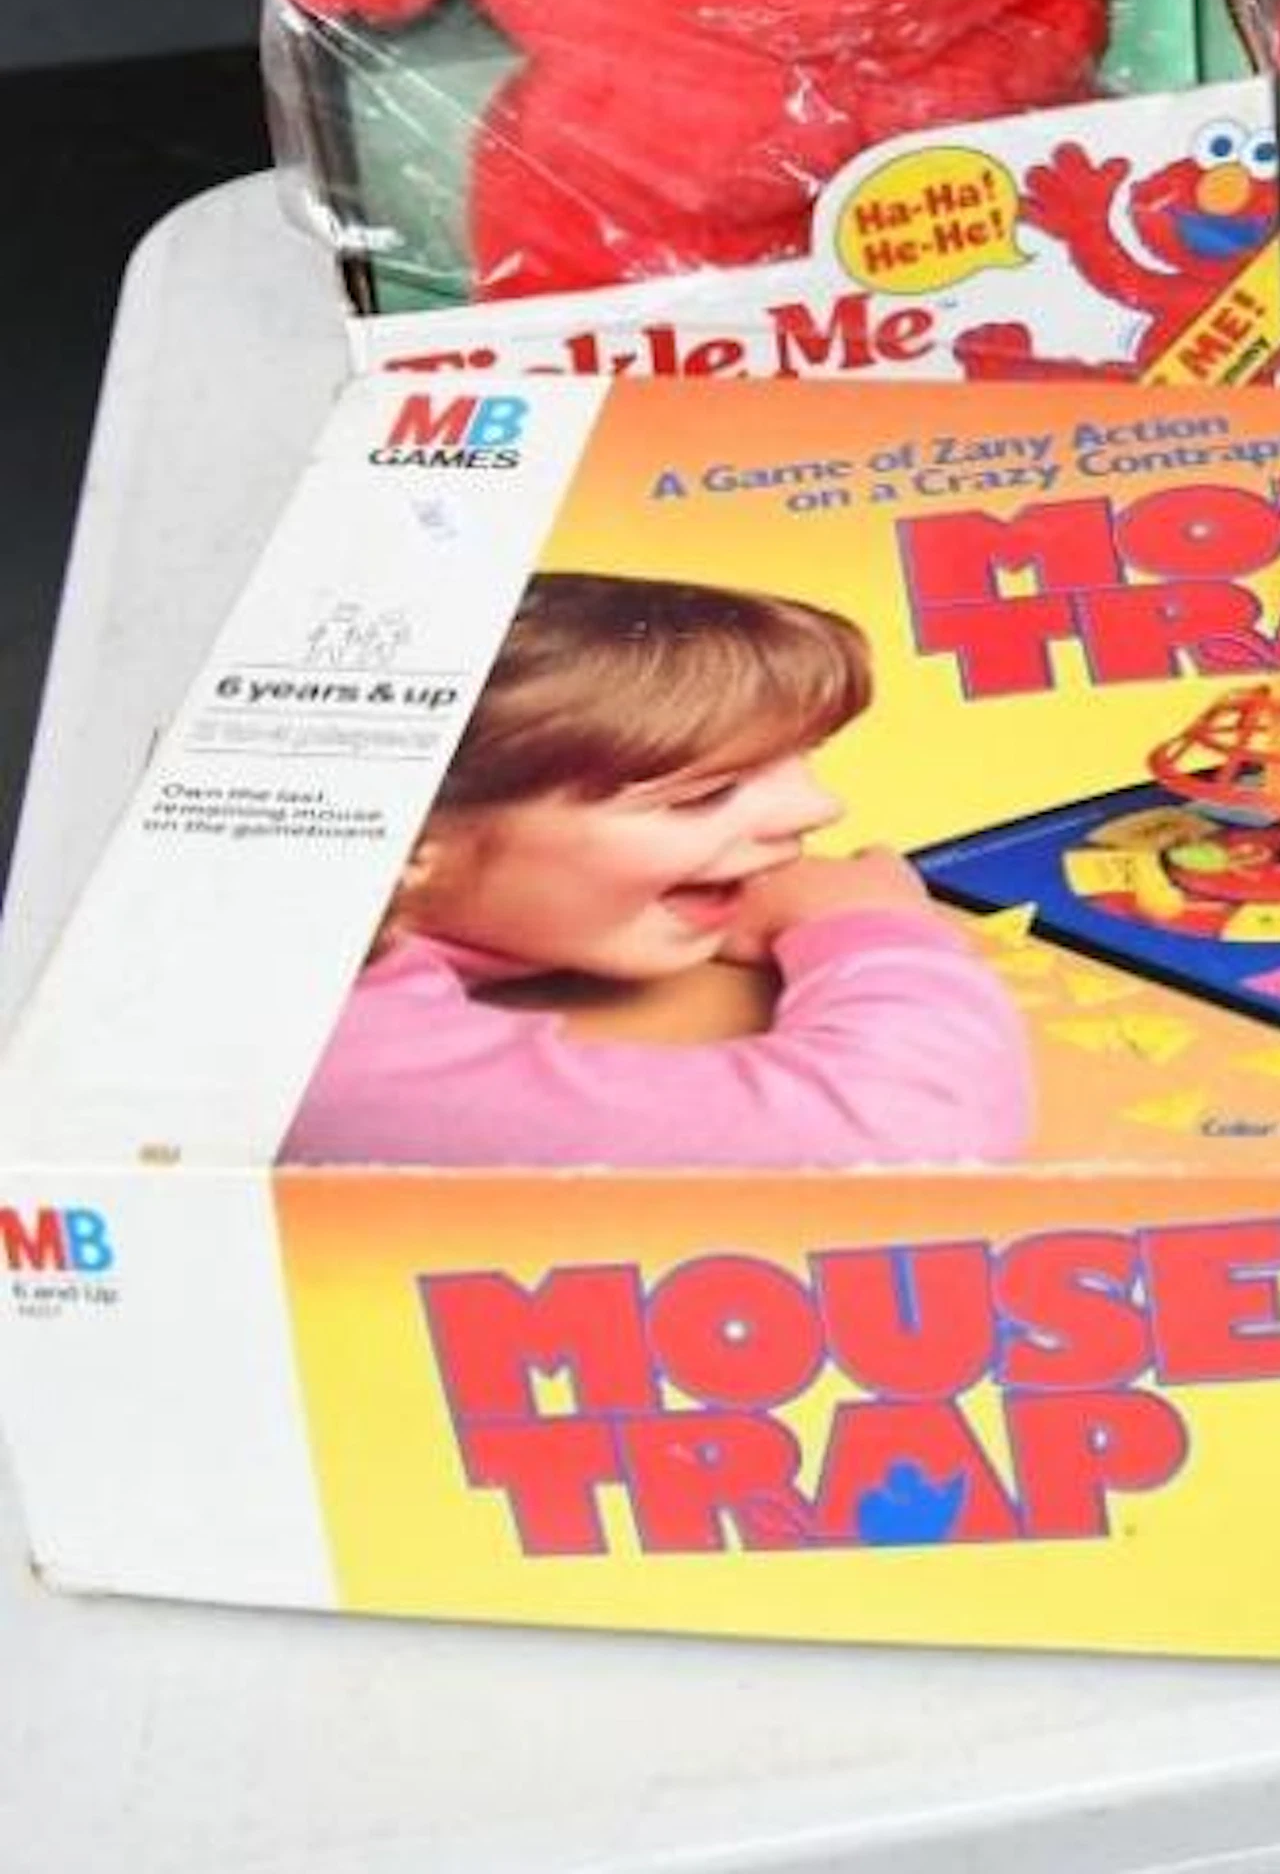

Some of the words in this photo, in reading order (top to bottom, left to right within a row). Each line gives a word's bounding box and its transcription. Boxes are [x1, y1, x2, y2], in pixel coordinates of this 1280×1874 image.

[854, 169, 996, 236] Ha-Ha!
[863, 207, 1006, 275] He-He!
[766, 293, 935, 377] Me
[385, 392, 531, 447] MB
[368, 446, 523, 471] GAMES
[653, 468, 687, 500] A
[702, 460, 852, 493] Game
[867, 441, 918, 474] of
[932, 433, 1054, 465] Zany
[1073, 414, 1230, 450] Action
[786, 488, 852, 512] on
[870, 482, 899, 503] a
[911, 462, 1062, 497] Crazy
[215, 675, 243, 699] 6
[249, 680, 360, 704] years
[366, 681, 396, 703] &
[403, 685, 458, 711] up
[162, 782, 223, 800] Own
[1201, 1118, 1270, 1137] Color
[0, 1206, 115, 1272] MB
[460, 1386, 1191, 1558] TRAP
